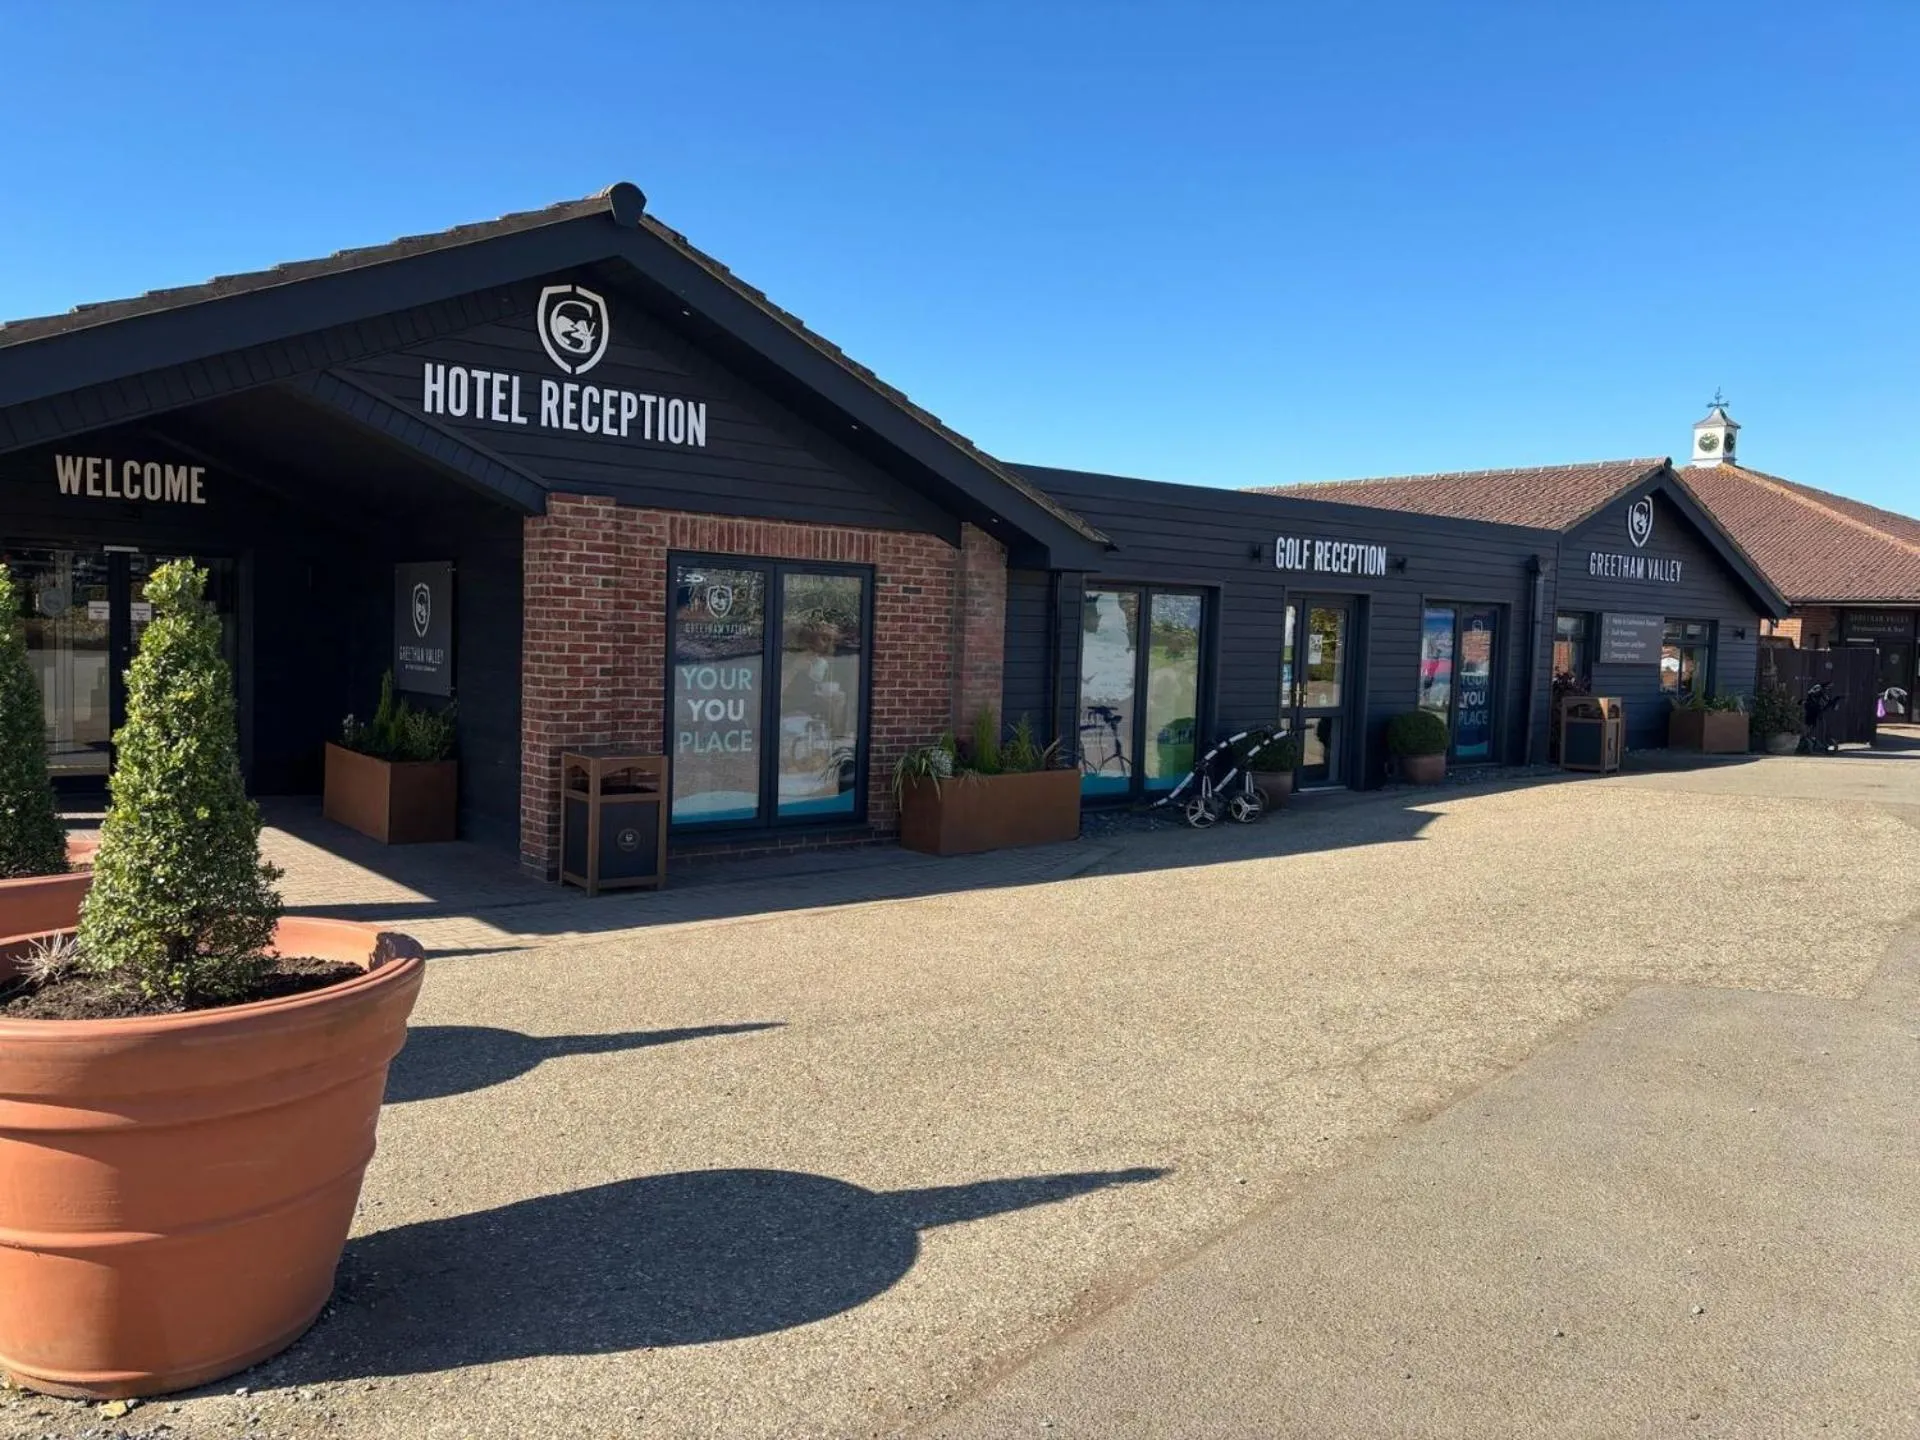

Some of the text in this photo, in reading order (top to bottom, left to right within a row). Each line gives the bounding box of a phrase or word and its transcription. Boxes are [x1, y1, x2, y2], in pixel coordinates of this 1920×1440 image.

[423, 362, 707, 448] HOTEL RECEPTION
[55, 454, 207, 505] WELCOME
[1276, 536, 1387, 576] GOLF RECEPTION
[1590, 552, 1682, 582] GREETHAM VALLEY
[681, 666, 753, 691] YOUR
[687, 698, 745, 722] YOU
[1462, 691, 1486, 706] YOU
[1459, 710, 1488, 726] PLACE
[679, 729, 753, 754] PLACE
